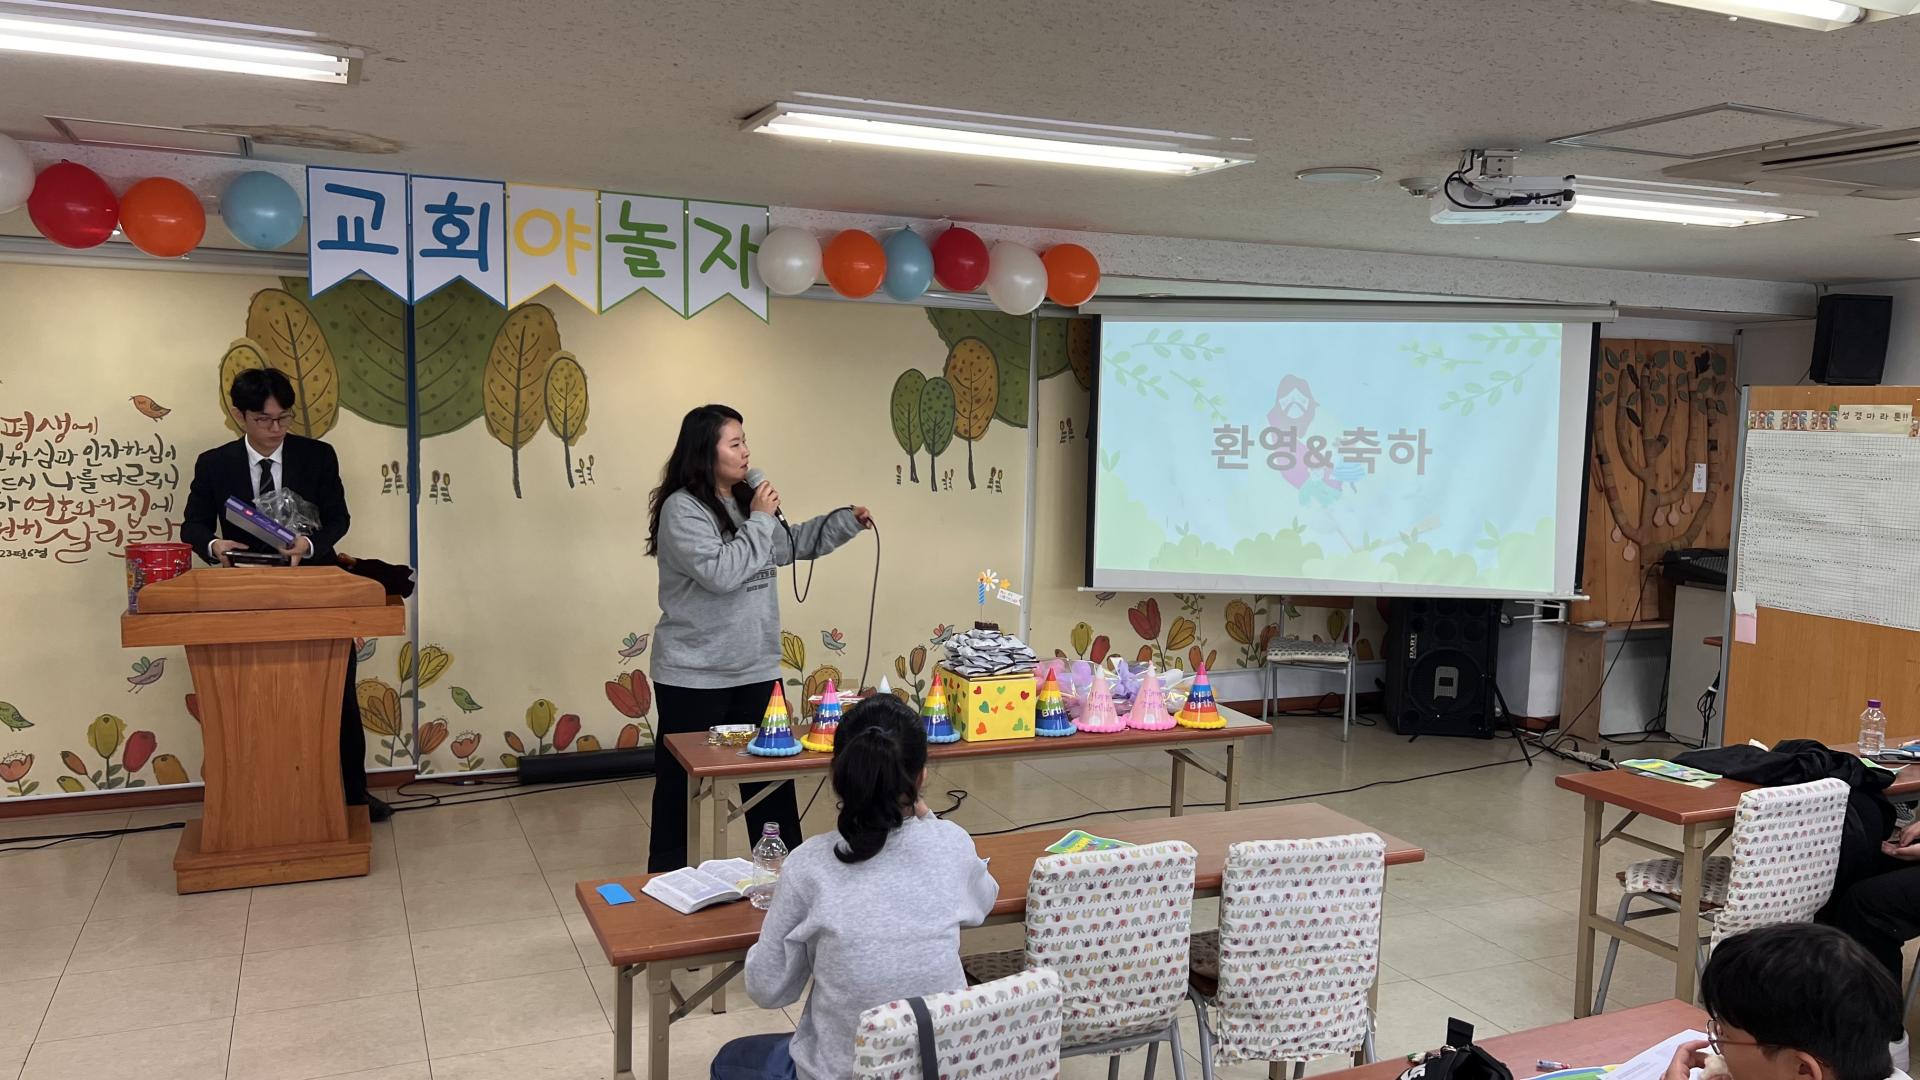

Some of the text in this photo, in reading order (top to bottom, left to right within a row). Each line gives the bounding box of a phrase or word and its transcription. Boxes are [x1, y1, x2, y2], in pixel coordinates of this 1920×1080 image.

[0, 411, 99, 450] 평생에
[1211, 423, 1433, 476] 환영&축하
[0, 432, 177, 471] 하심과 인자하심이
[0, 463, 179, 494] 드시 나를 따르리니
[23, 492, 115, 525] 여호와의
[117, 488, 174, 529] 집에
[1409, 632, 1418, 660] DART
